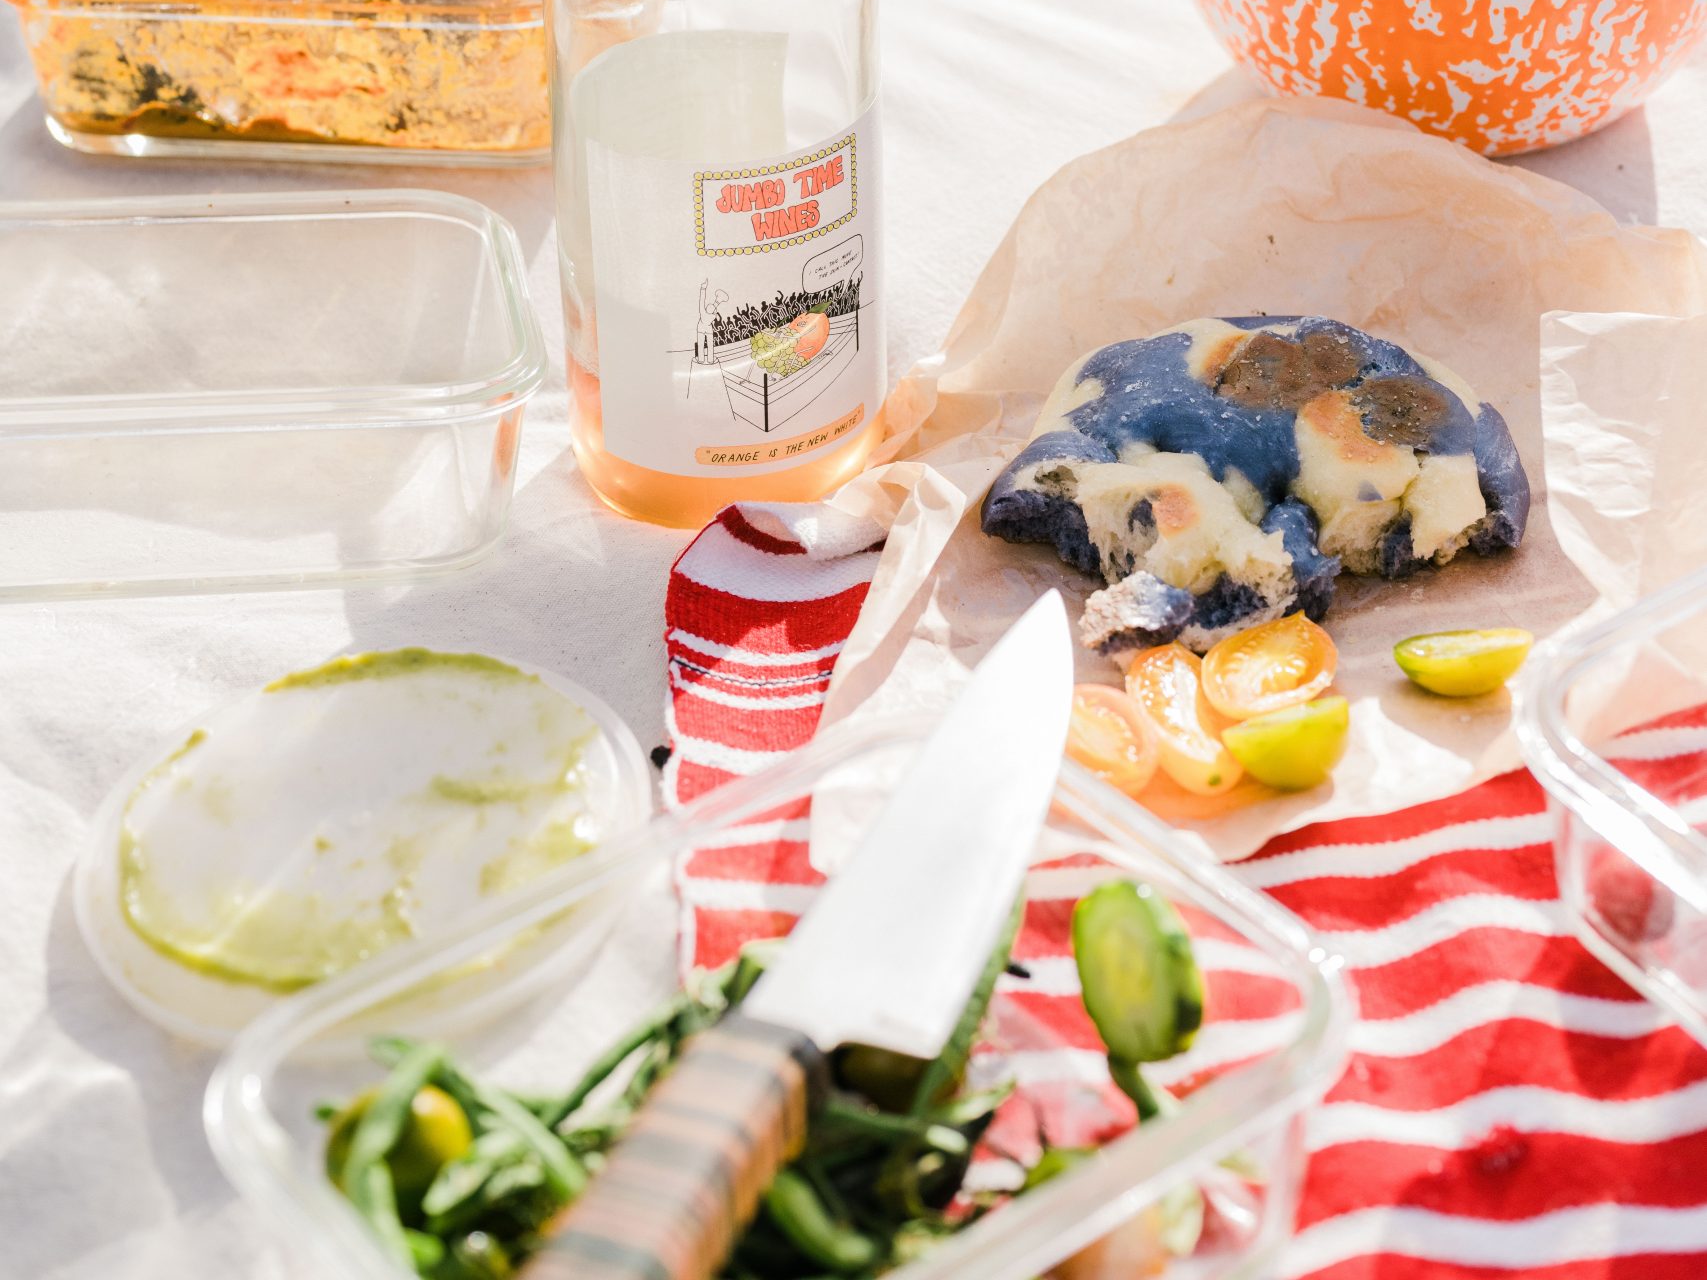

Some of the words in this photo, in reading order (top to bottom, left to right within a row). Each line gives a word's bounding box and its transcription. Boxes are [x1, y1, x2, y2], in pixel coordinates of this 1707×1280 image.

[716, 178, 786, 213] JUMBO
[793, 155, 844, 199] TIME
[751, 200, 820, 241] WINES
[768, 448, 778, 458] IS
[786, 441, 804, 455] THE
[806, 432, 829, 447] NEW
